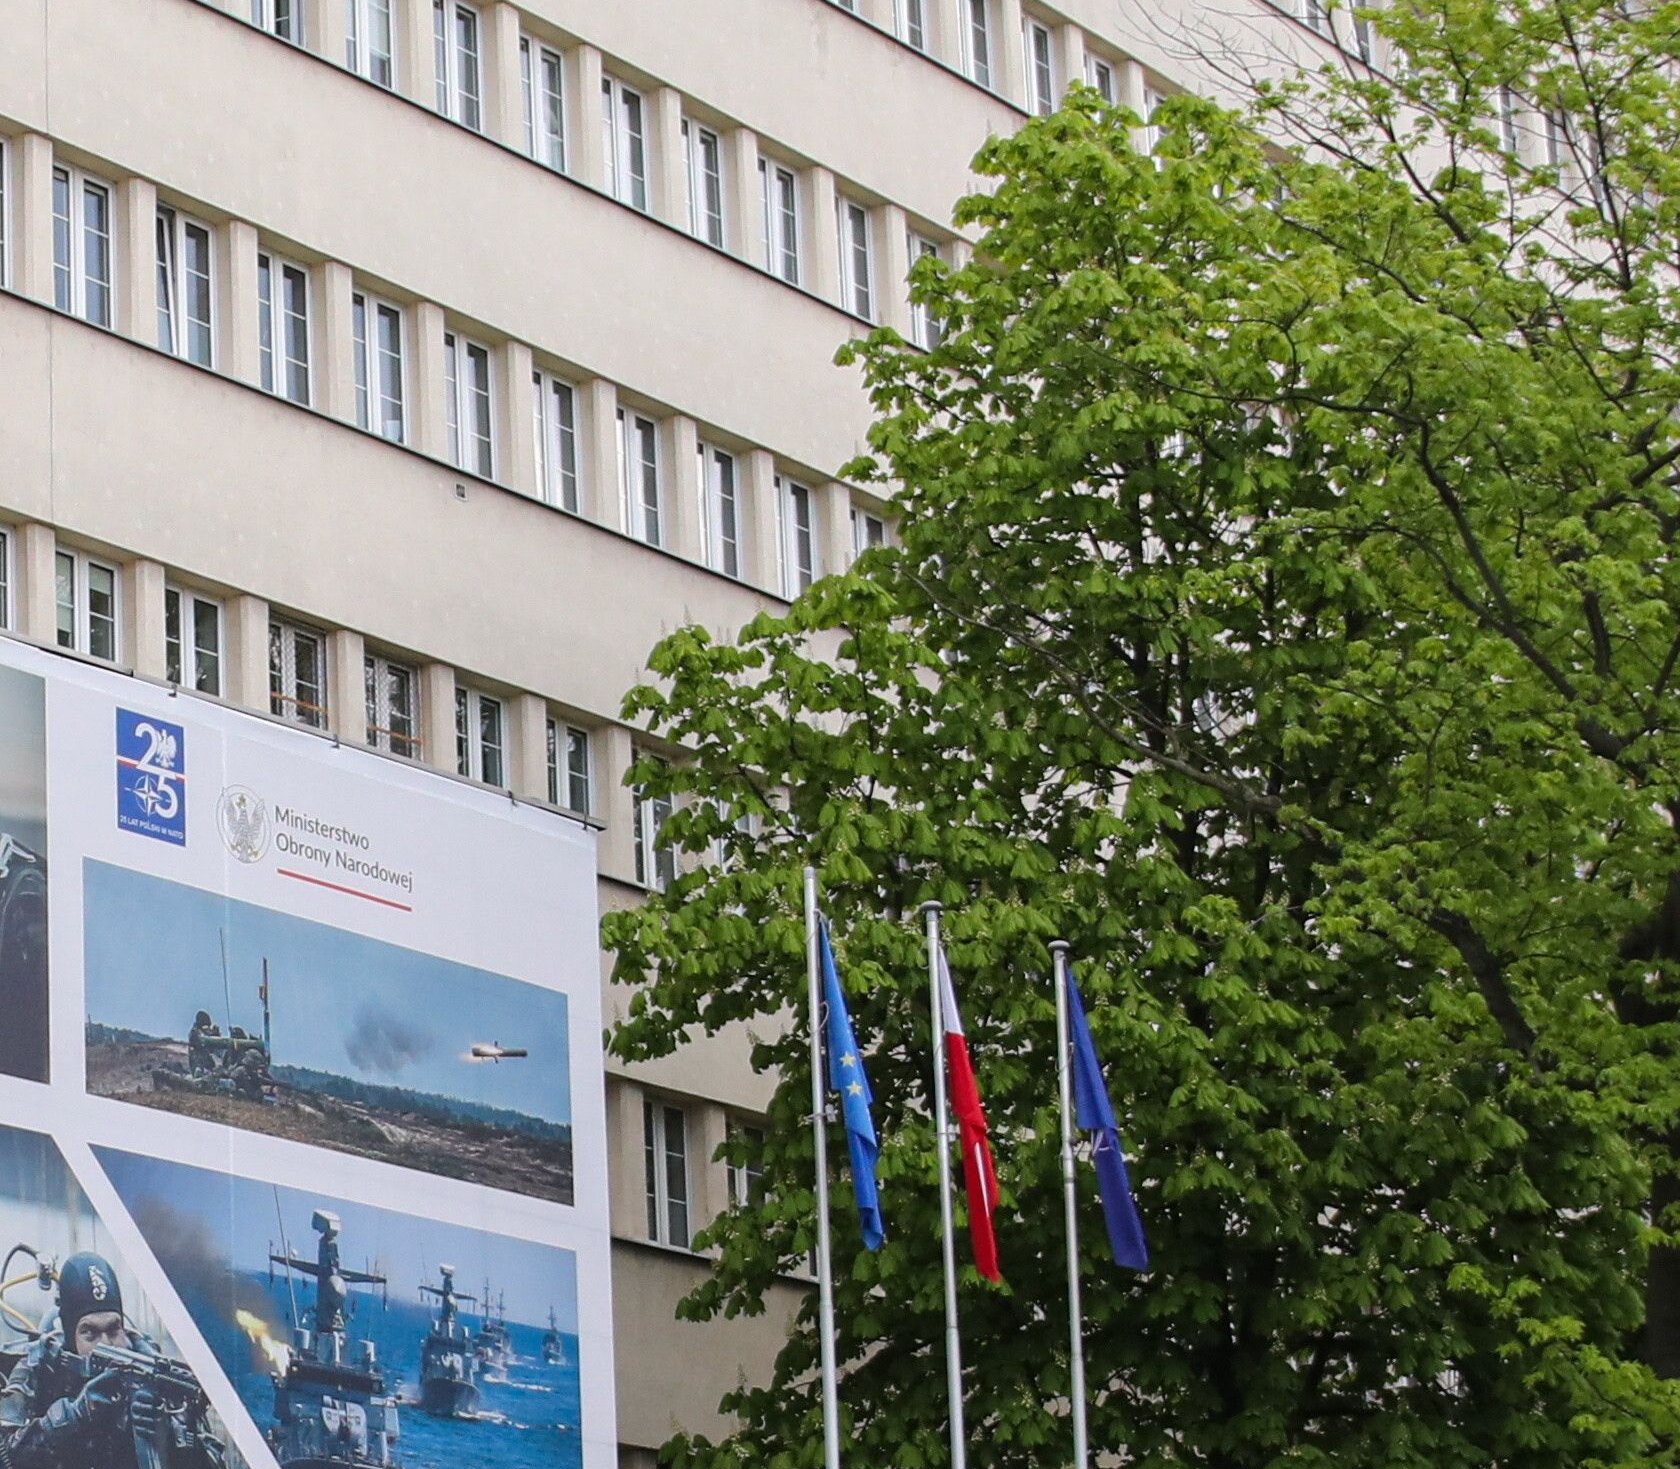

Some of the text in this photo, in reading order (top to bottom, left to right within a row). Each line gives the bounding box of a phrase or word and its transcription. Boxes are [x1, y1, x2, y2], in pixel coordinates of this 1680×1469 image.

[275, 805, 370, 850] Ministerstwo
[276, 832, 413, 894] Obrony Narodowej
